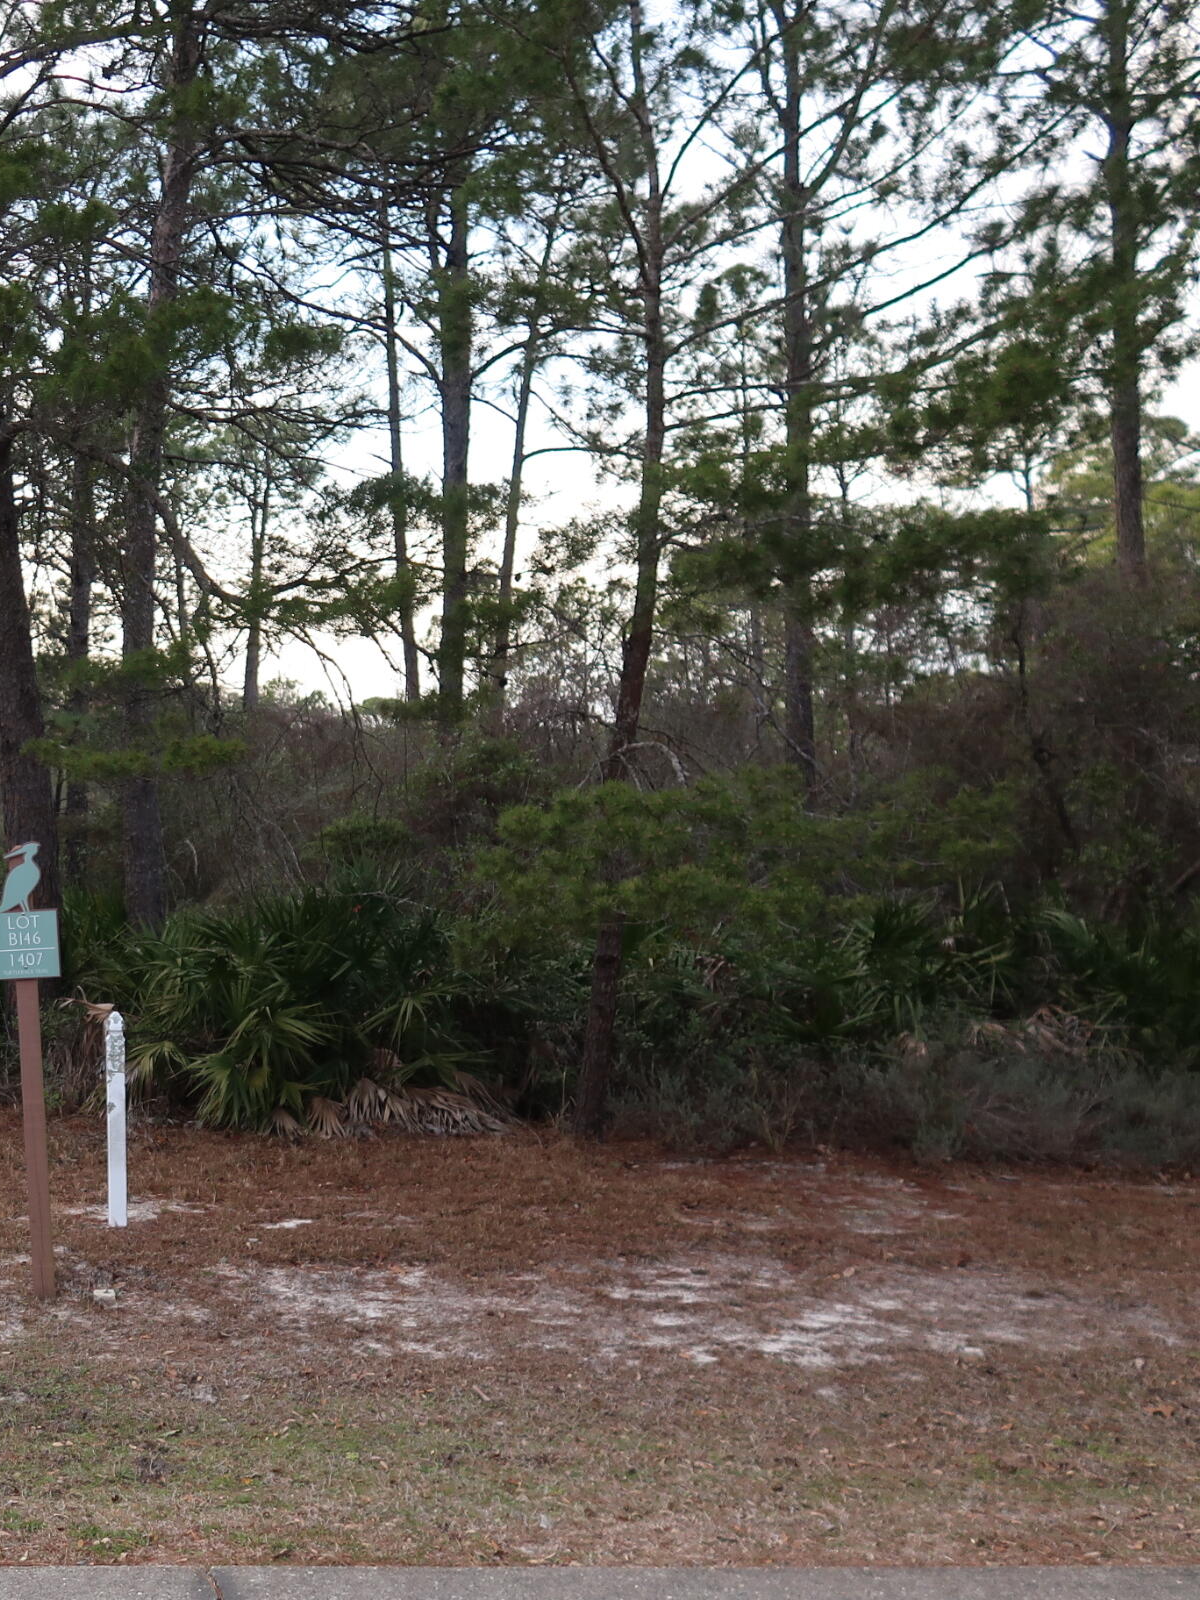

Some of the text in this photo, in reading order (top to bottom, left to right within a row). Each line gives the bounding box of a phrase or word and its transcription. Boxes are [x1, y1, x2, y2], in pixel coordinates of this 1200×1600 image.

[8, 915, 40, 930] LOT
[8, 932, 41, 946] B146
[10, 953, 43, 967] 1407
